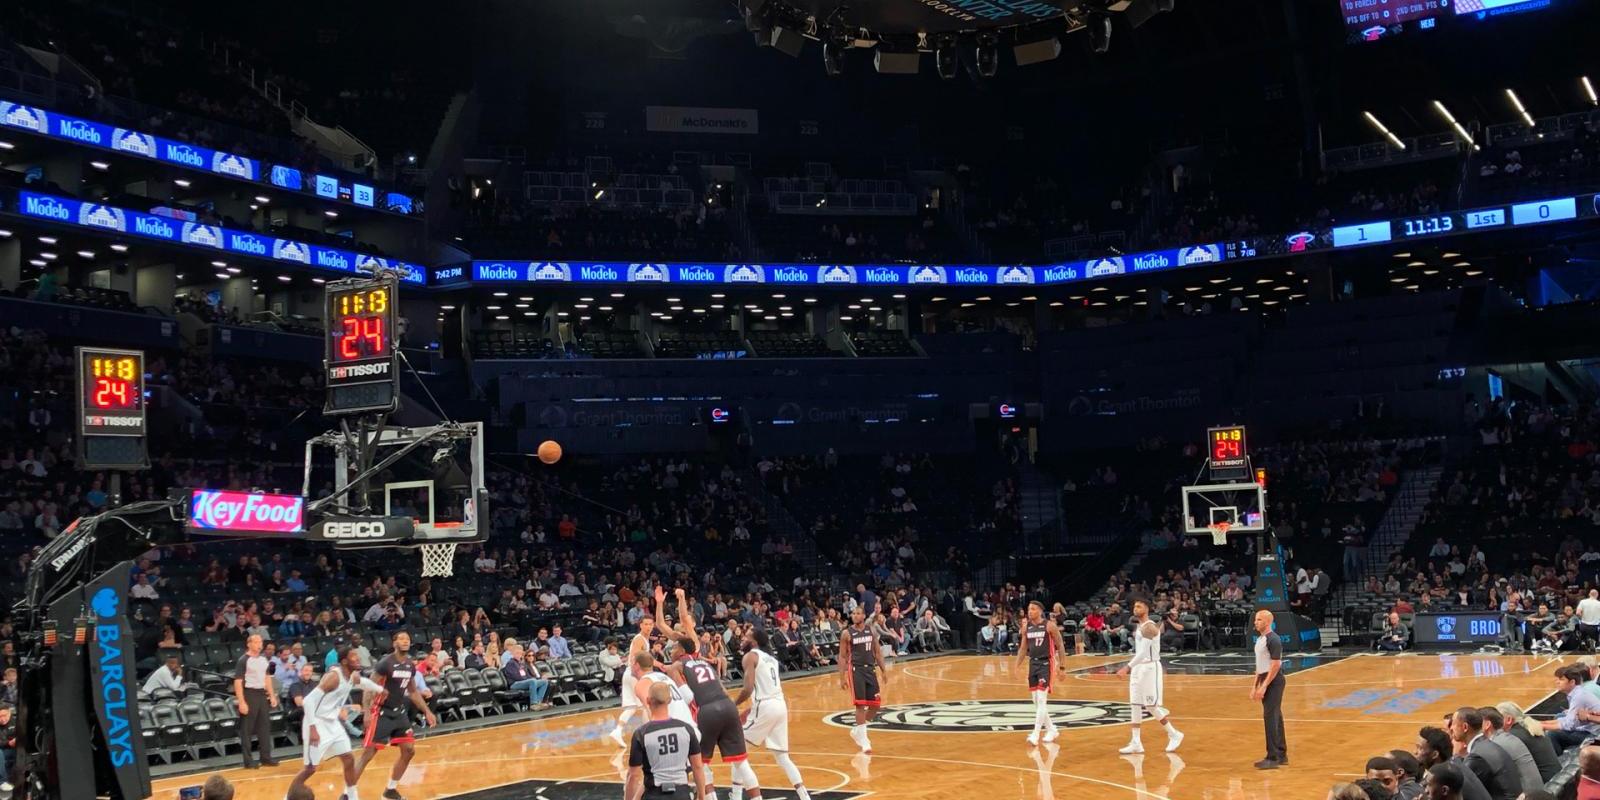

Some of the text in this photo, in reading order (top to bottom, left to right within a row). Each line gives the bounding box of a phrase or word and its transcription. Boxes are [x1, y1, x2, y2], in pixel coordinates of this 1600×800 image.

[60, 119, 100, 144] Modelo
[167, 144, 203, 167] Modelo
[322, 182, 333, 193] 20
[359, 190, 370, 202] 33
[27, 197, 69, 220] Modelo
[1538, 204, 1549, 219] 0
[135, 216, 173, 238] Modelo
[1405, 216, 1453, 236] 11:13
[1474, 212, 1496, 226] 1st
[1358, 228, 1368, 241] 1
[231, 234, 266, 255] Modelo
[318, 250, 348, 270] Modelo
[1134, 255, 1168, 270] Modelo
[435, 267, 462, 280] 7:42 PM
[480, 265, 517, 280] Modelo
[581, 266, 618, 281] Modelo
[679, 267, 715, 281] Modelo
[774, 268, 808, 282] Modelo
[866, 269, 899, 283] Modelo
[955, 269, 988, 283] Modelo
[1044, 267, 1077, 282] Modelo
[342, 290, 386, 315] 11:13
[341, 318, 381, 357] 24
[96, 380, 126, 406] 24
[1216, 430, 1241, 440] 11:13
[1216, 441, 1239, 458] 24
[195, 491, 301, 526] Key Food
[323, 521, 385, 538] GEICO
[1035, 638, 1044, 647] 17
[694, 666, 716, 684] 21
[770, 667, 777, 687] 9
[97, 624, 135, 768] BARCLAYS
[658, 733, 679, 755] 39
